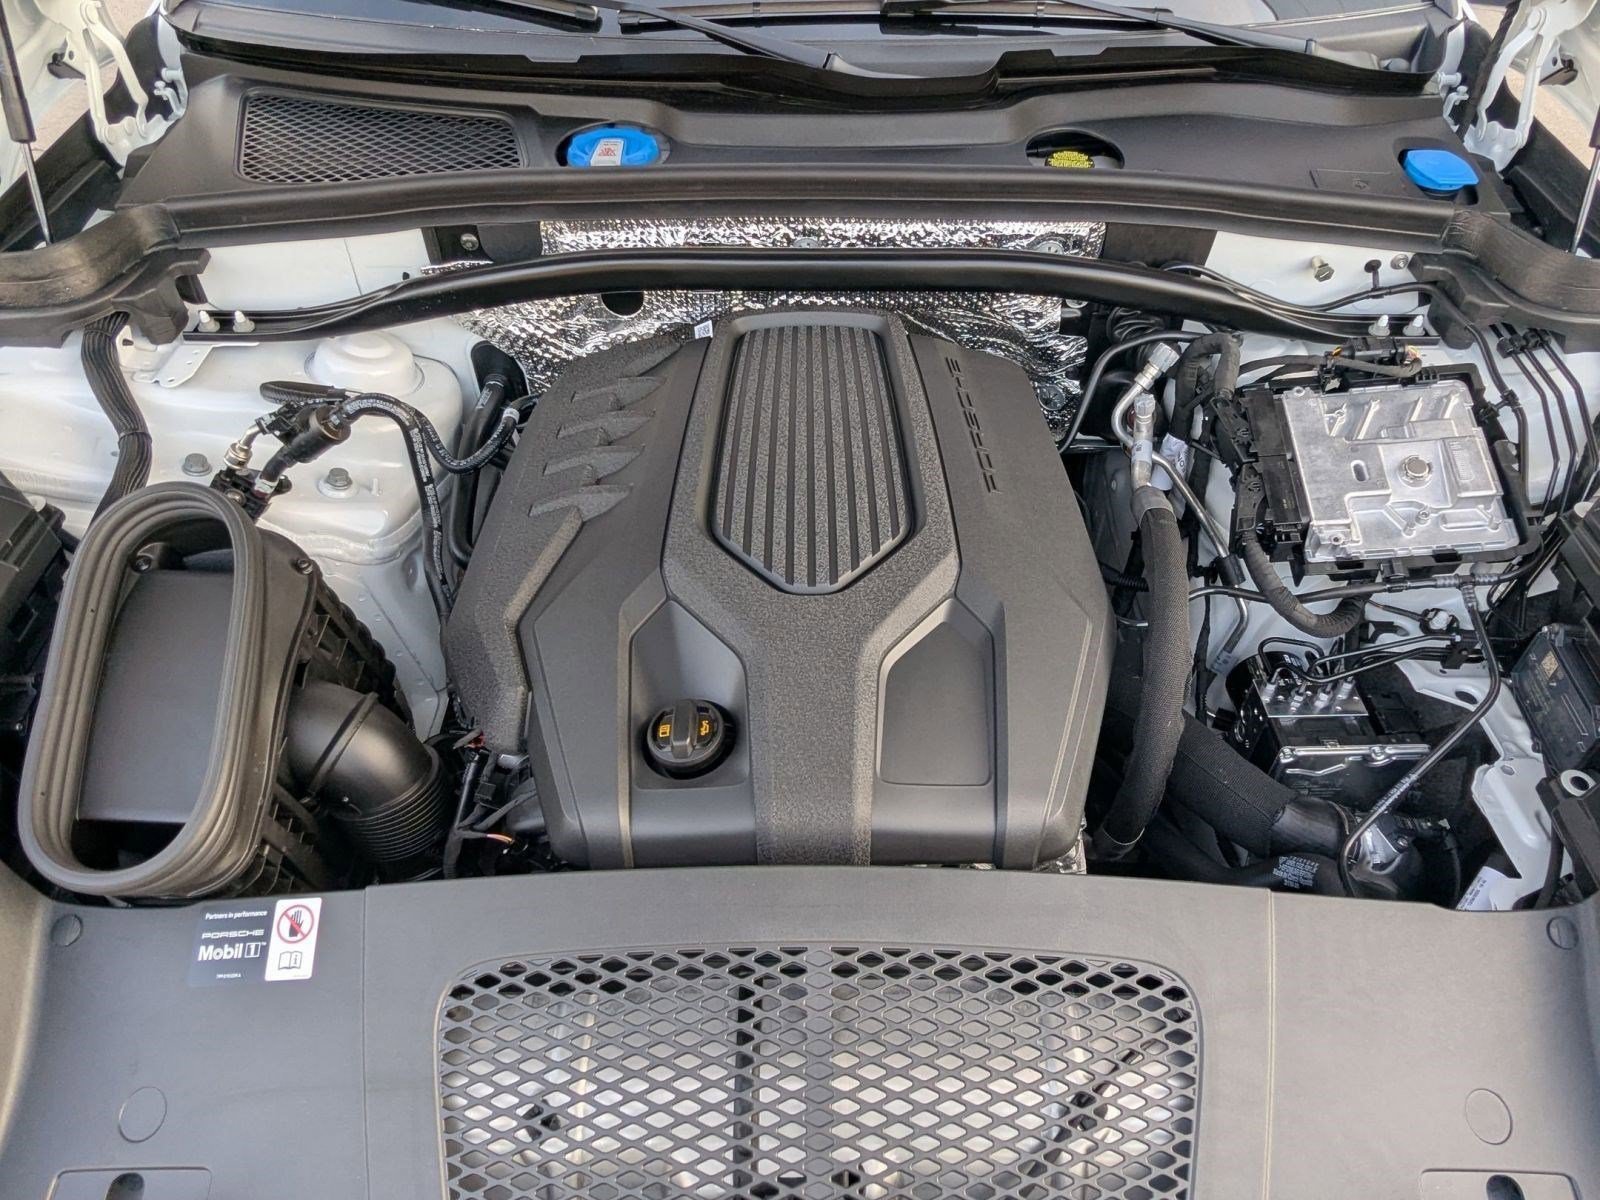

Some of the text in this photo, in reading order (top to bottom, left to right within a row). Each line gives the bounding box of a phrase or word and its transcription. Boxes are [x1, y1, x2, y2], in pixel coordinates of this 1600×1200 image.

[946, 357, 1000, 493] PORSCHE
[205, 912, 228, 920] Partners
[234, 910, 268, 919] performance
[202, 929, 265, 939] PORSCHE
[198, 943, 244, 960] Mobil
